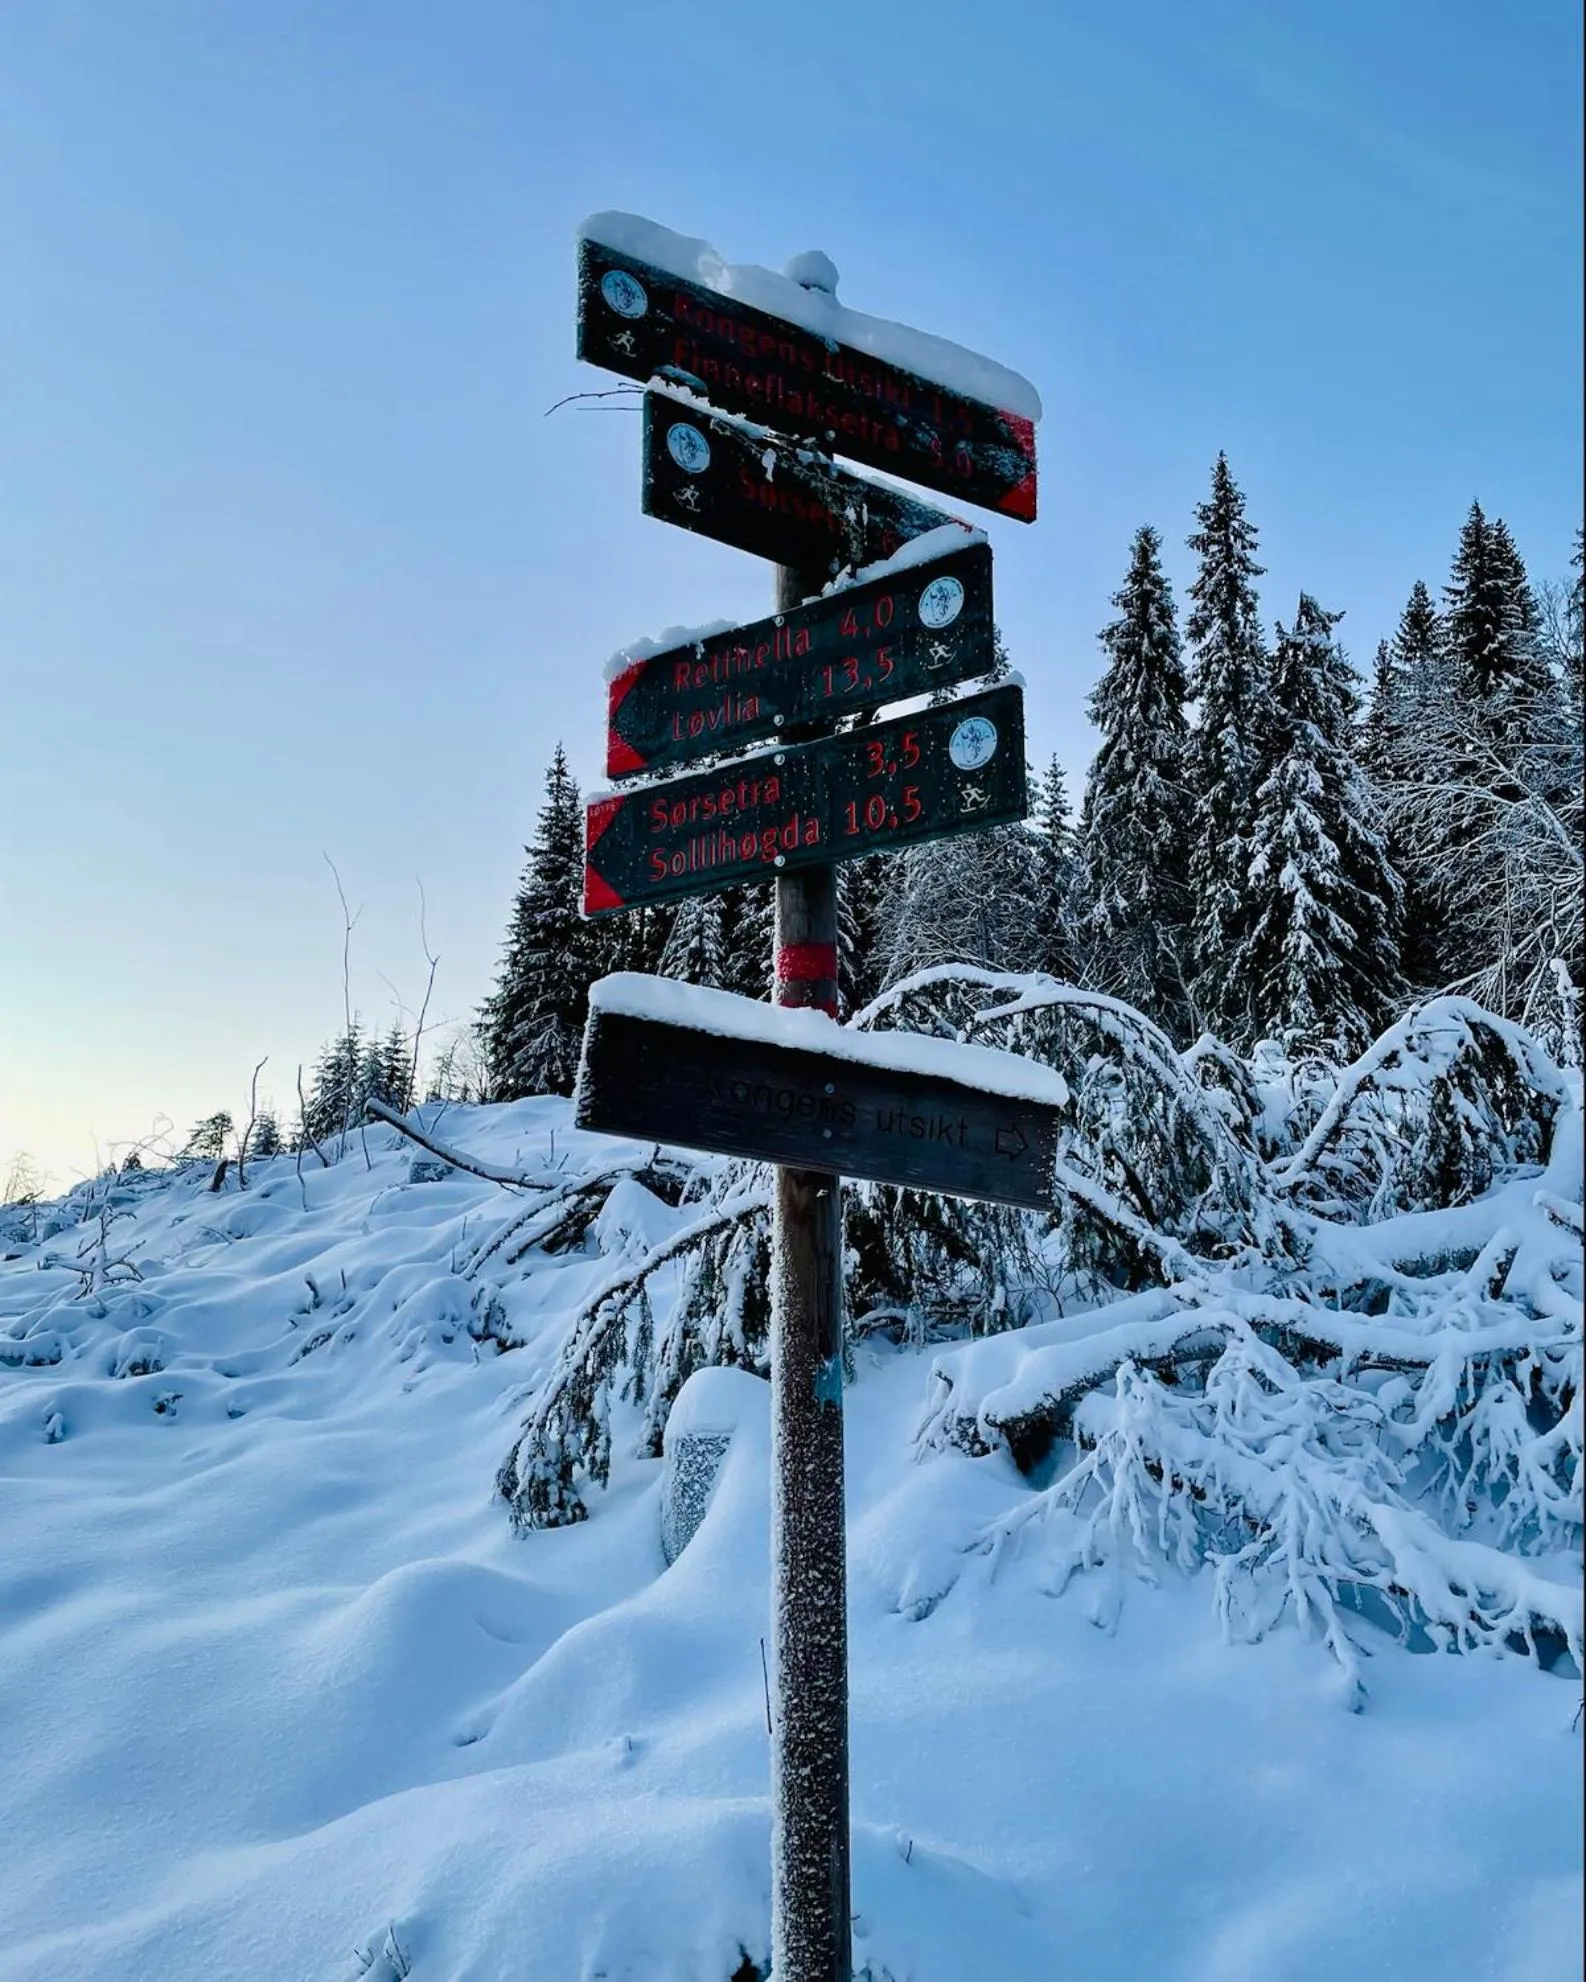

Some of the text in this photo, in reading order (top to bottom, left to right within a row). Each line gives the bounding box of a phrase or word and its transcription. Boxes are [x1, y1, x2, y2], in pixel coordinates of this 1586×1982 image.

[673, 294, 815, 372] Kongens
[673, 337, 902, 453] Finneflaksetra
[672, 627, 812, 692] Retthella
[838, 594, 895, 638] 4,0
[671, 645, 895, 742] Løvlia 13,5
[649, 774, 782, 833] Sørsetra
[865, 730, 922, 779] 3,5
[648, 784, 923, 883] Sollihøgda 10,5
[704, 1068, 969, 1146] Kongens utsikt
